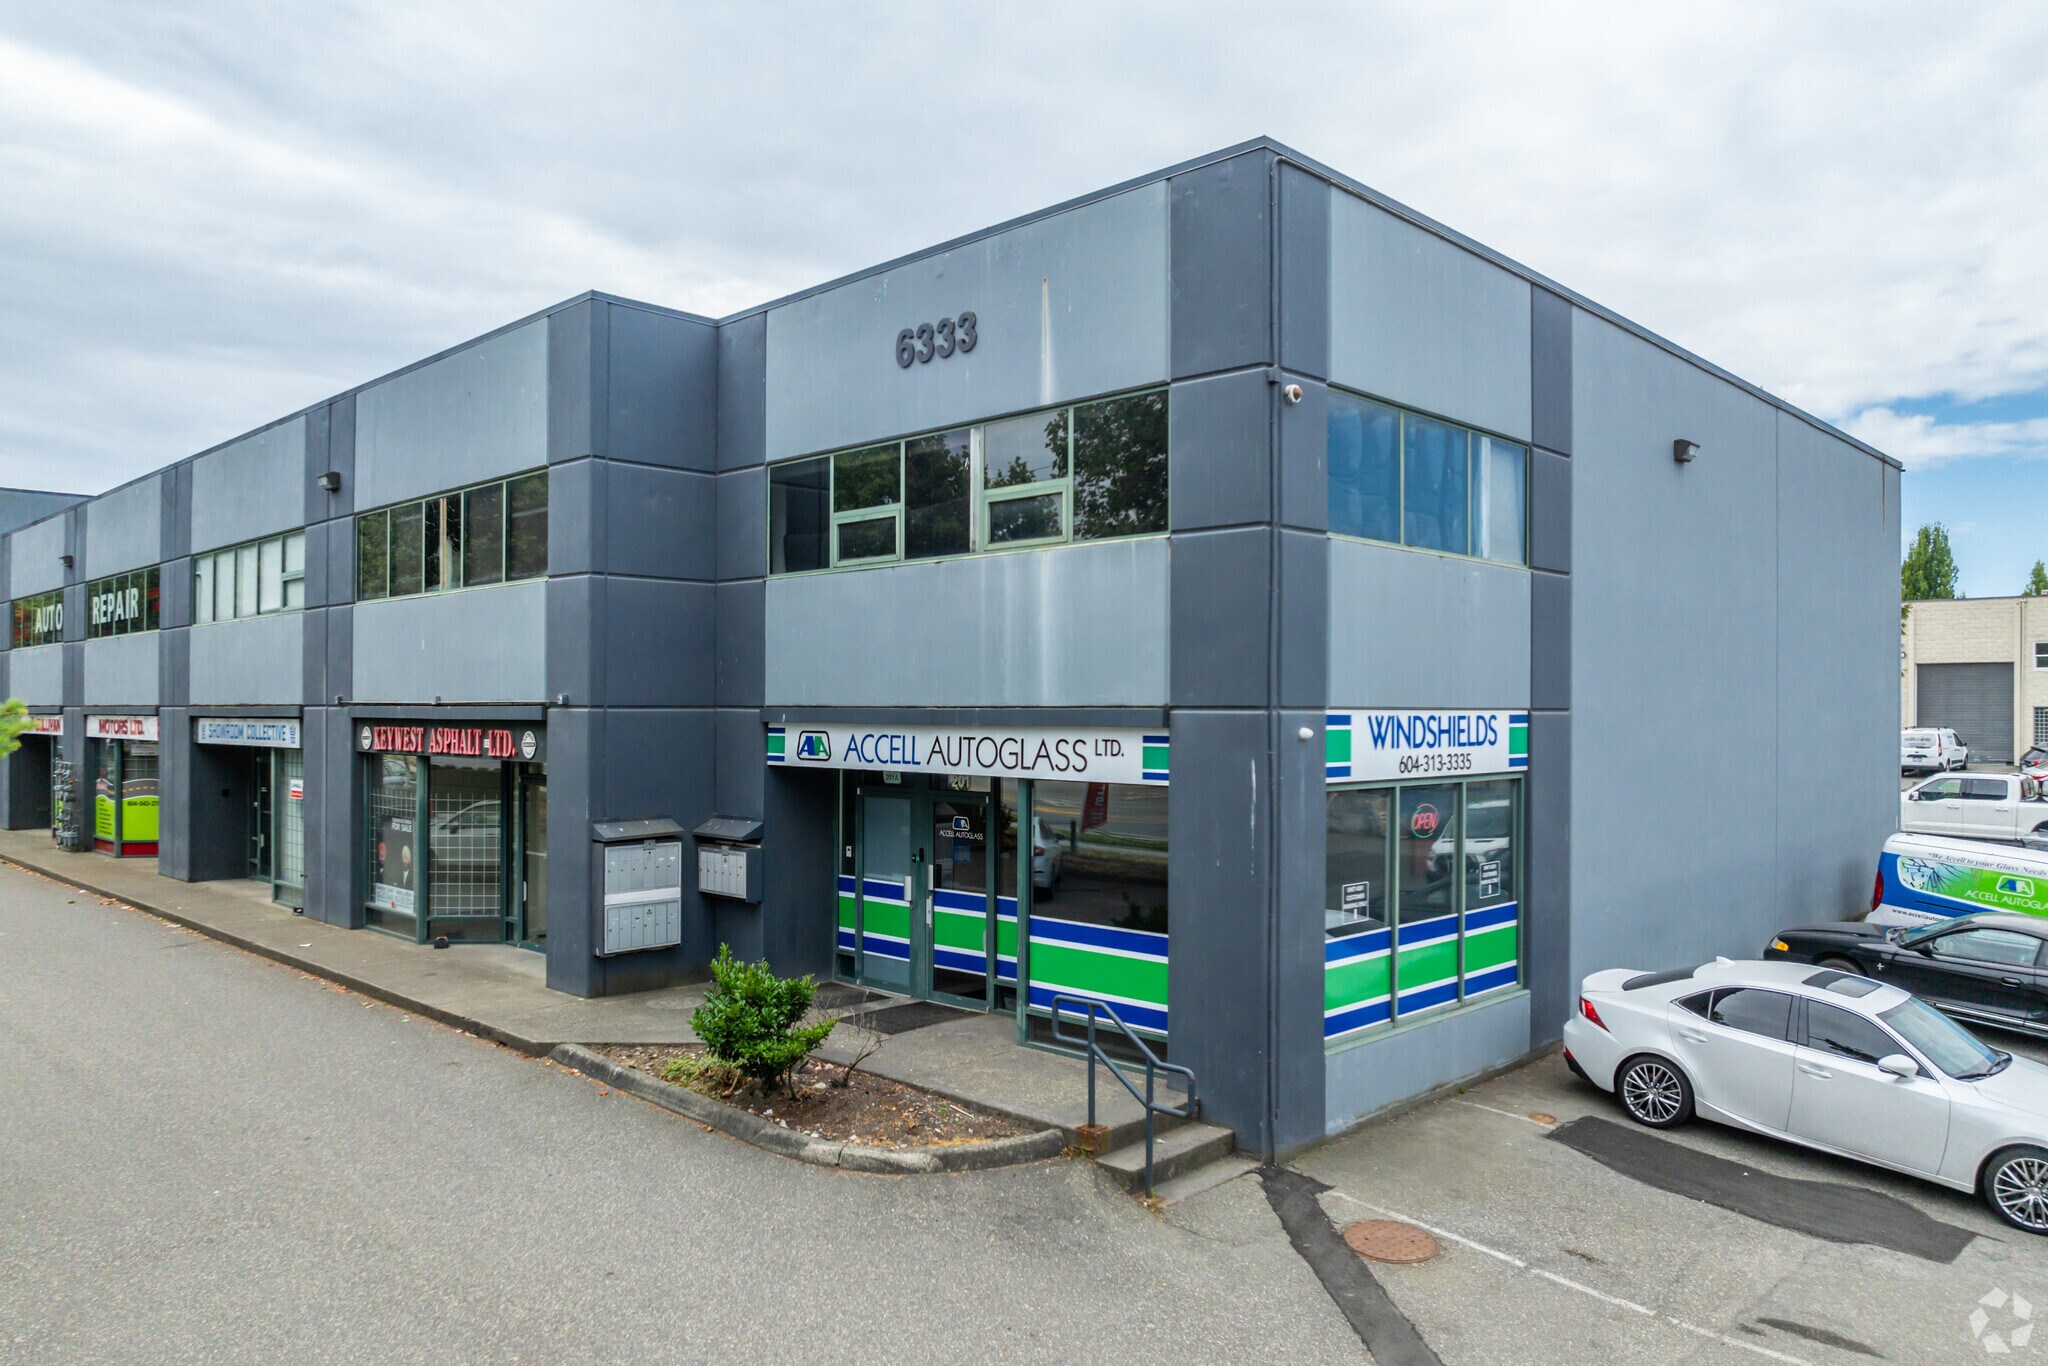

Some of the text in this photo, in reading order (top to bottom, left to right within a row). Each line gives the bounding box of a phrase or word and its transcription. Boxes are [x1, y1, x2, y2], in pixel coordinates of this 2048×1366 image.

[896, 311, 977, 369] 6333
[35, 588, 139, 633] AUTO REPAIR
[99, 719, 128, 734] MOTORS
[209, 724, 286, 741] SHOWROOM COLLECTIVE
[1368, 715, 1498, 750] WINDSHIELDS
[373, 726, 517, 757] KEYWEST ASPHALT LTD.
[844, 734, 921, 765] ACCELL
[927, 736, 1088, 773] AUTOGLASS
[1095, 739, 1125, 757] LTD.
[1399, 753, 1472, 773] 604-313-3335
[952, 776, 970, 788] 201
[401, 824, 413, 833] SALE
[1413, 812, 1436, 830] OPEN
[956, 831, 983, 840] AUTOGLASS
[1975, 860, 1994, 869] your
[1996, 863, 2019, 872] Glass
[1965, 890, 1999, 902] ACCELL
